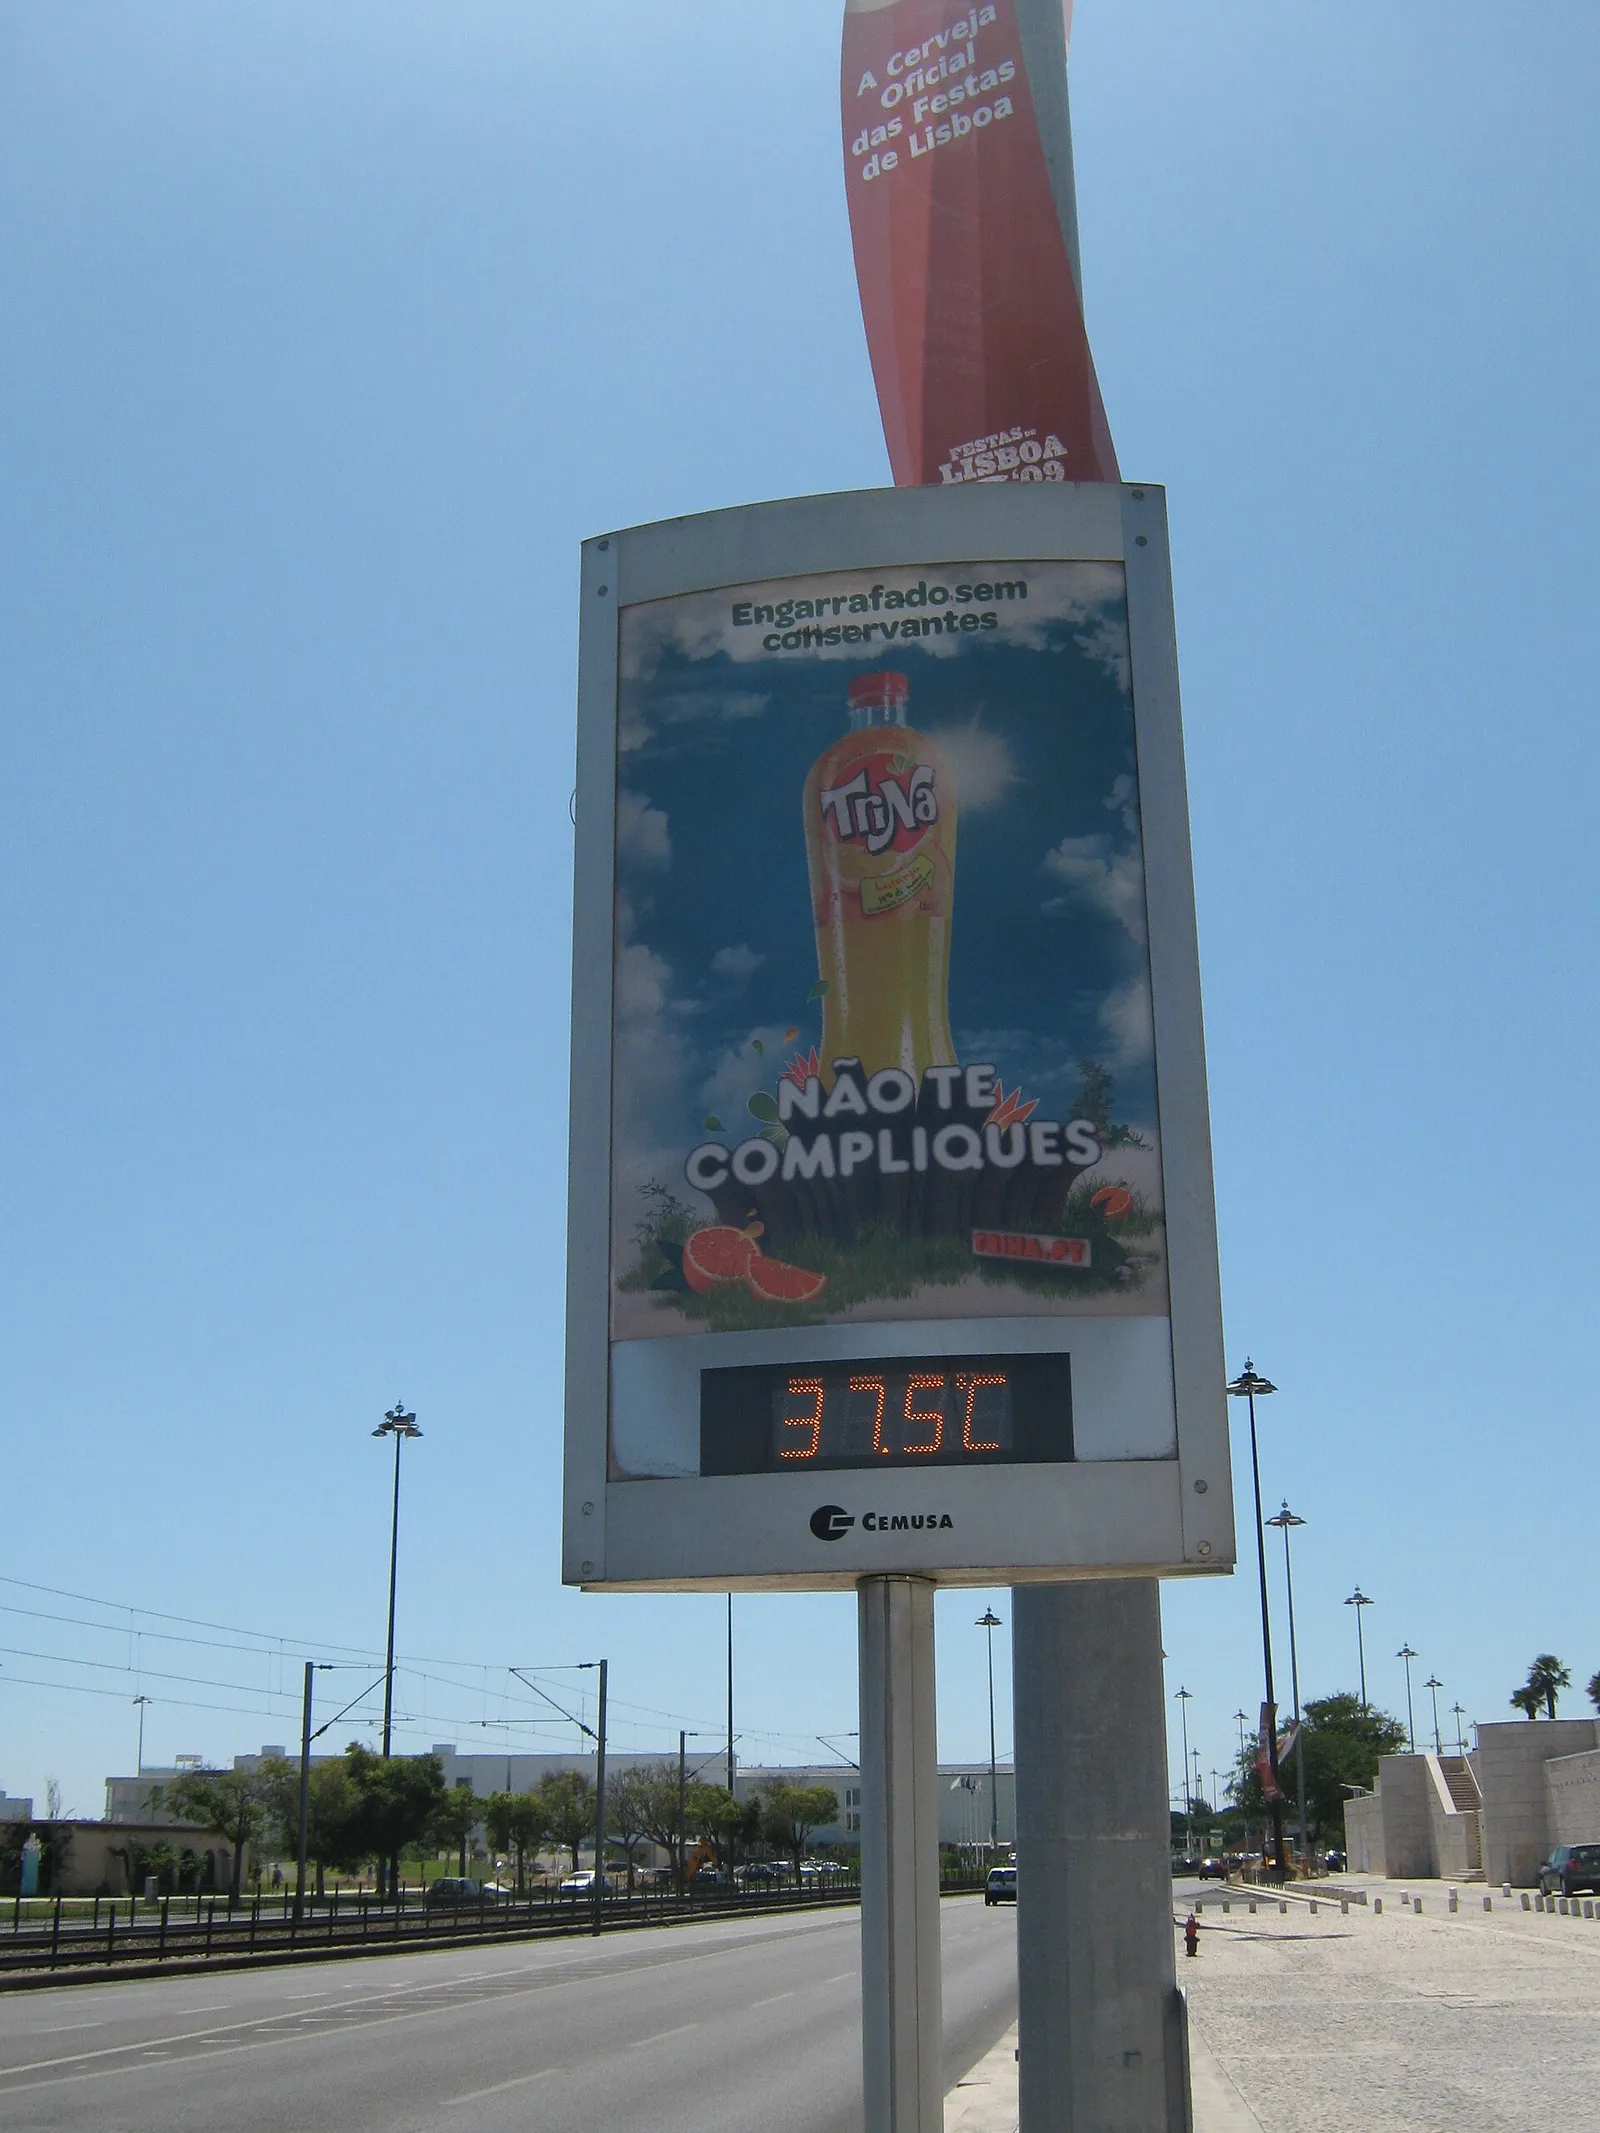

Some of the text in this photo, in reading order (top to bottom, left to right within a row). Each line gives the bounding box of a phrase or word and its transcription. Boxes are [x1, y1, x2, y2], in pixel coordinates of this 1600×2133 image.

[857, 4, 997, 96] A Cerveja
[881, 40, 976, 108] Oficial
[852, 59, 1015, 156] das Festas
[862, 96, 1014, 181] de Lisboa
[938, 434, 1068, 484] LISBOA
[950, 426, 1023, 461] FESTAS
[732, 580, 1028, 628] Engarrafado sem
[762, 610, 998, 651] conservantes
[777, 1056, 998, 1120] NÃO TE
[685, 1118, 1102, 1191] COMPLIQUES
